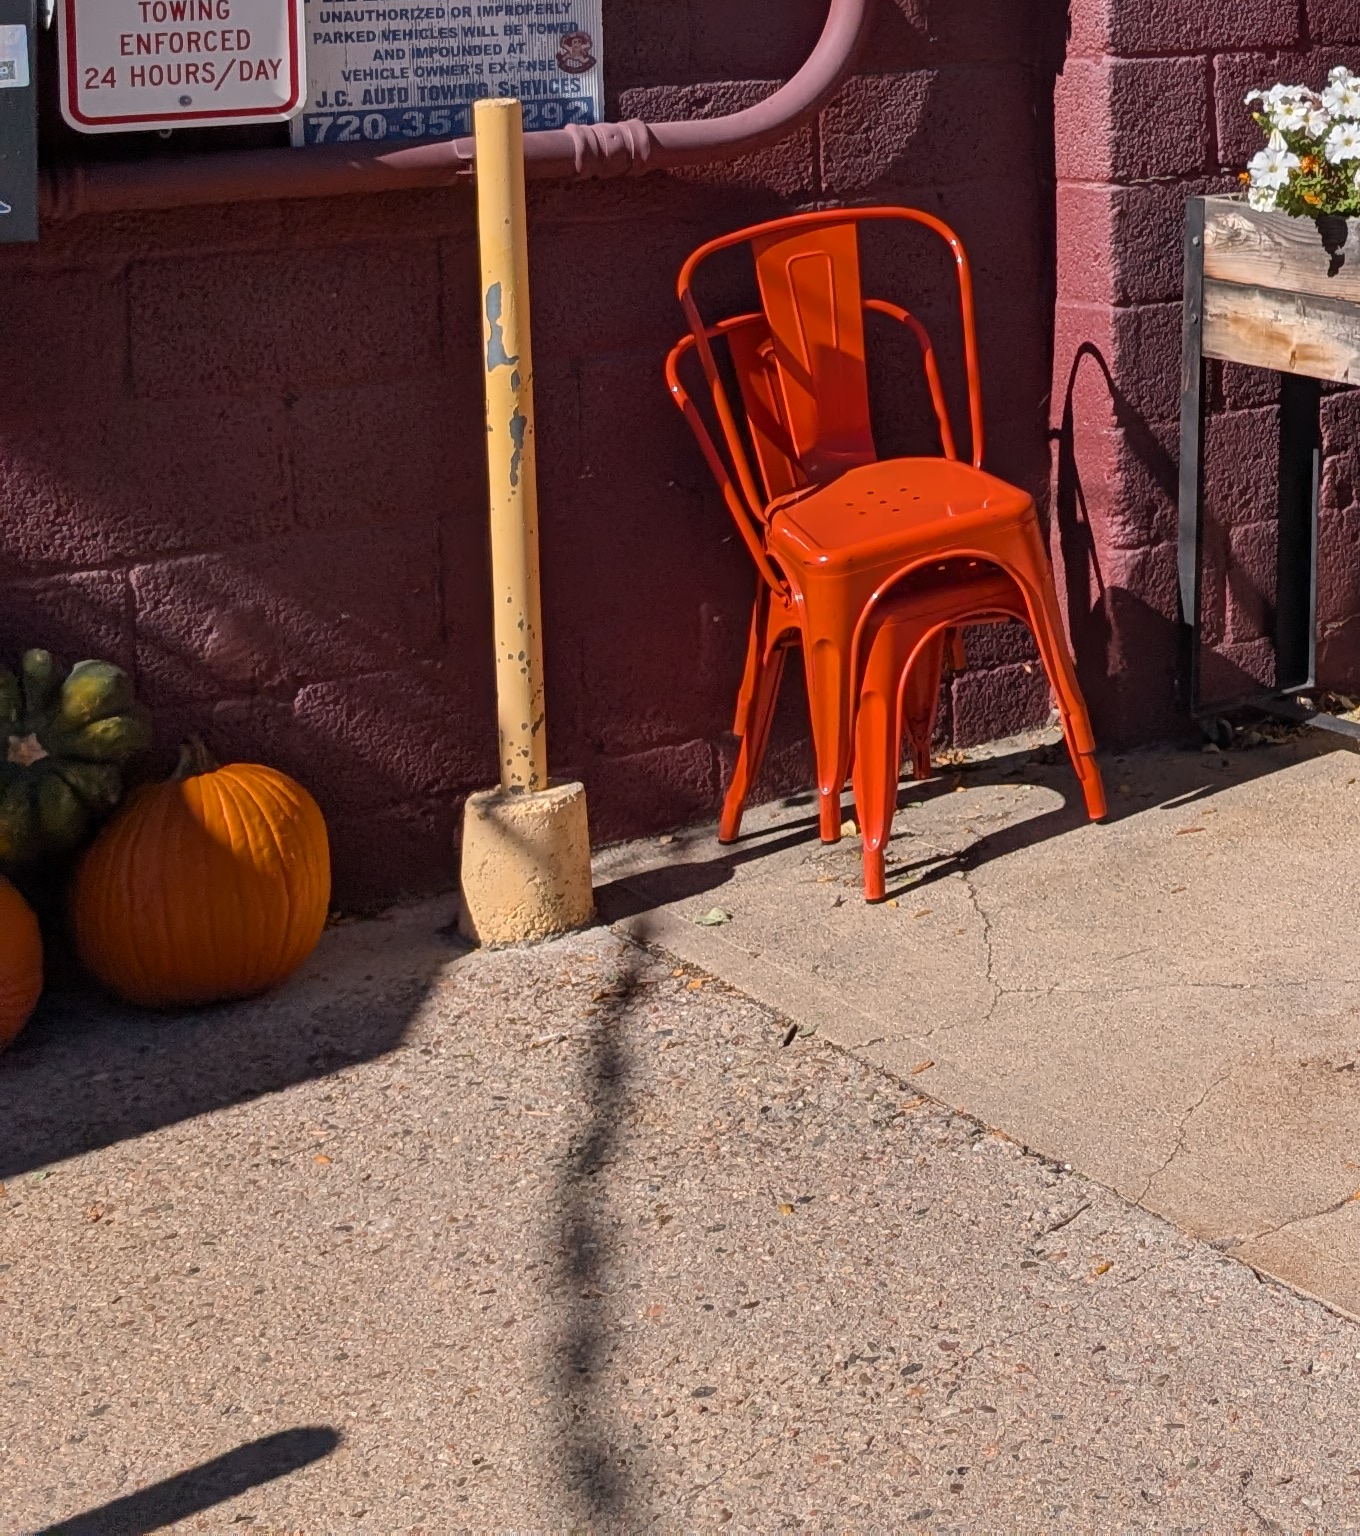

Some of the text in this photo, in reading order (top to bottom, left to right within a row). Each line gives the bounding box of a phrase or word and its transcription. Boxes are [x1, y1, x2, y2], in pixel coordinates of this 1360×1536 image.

[319, 2, 572, 23] UNAUTHORIZED OR IMPROPERLY
[120, 29, 251, 56] ENFORCED
[313, 21, 578, 45] PARKED VEHICLES WILL BE TOWED
[373, 42, 526, 62] AND IMPOUNDED AT
[85, 58, 283, 91] 24 HOURS/DAY
[341, 66, 410, 82] VEHICLE
[414, 62, 484, 79] OWNER'S
[315, 76, 582, 108] J.C. AUTO TOWING SERVICES
